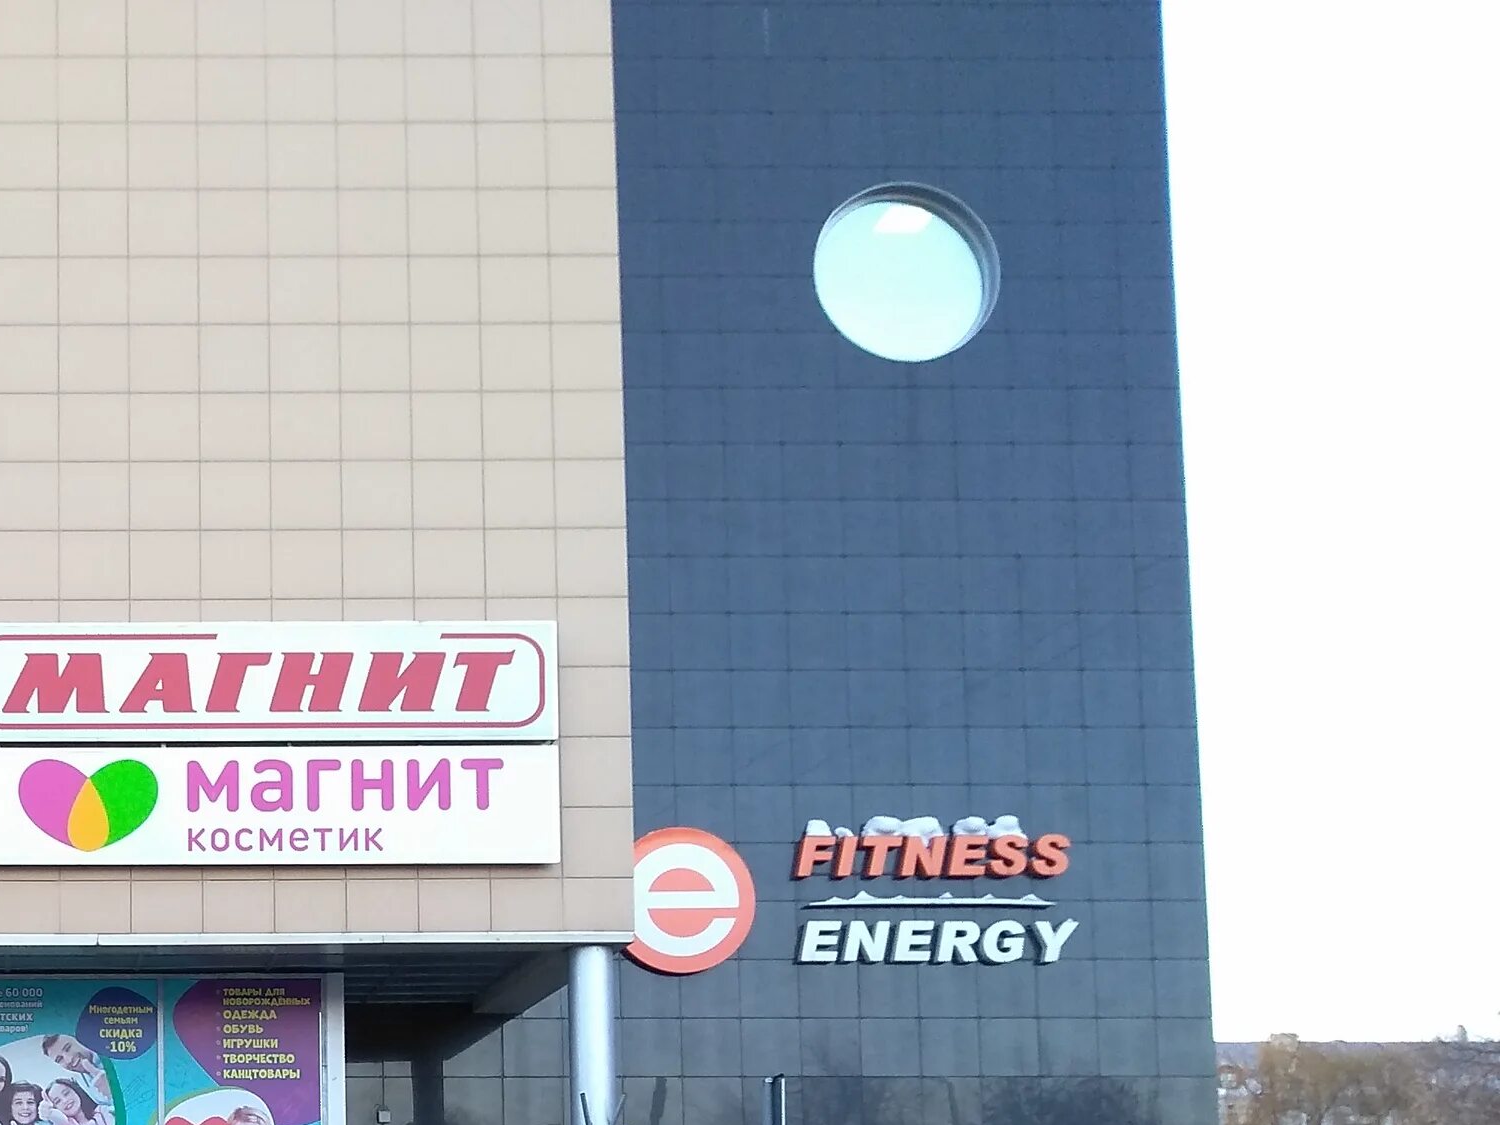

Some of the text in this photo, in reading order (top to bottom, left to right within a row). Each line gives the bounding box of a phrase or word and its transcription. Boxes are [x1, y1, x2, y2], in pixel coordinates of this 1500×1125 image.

[1, 649, 516, 714] МАГНИТ
[187, 827, 385, 853] косметик
[794, 832, 1071, 879] FITNESS
[798, 919, 1080, 965] ENERGY
[5, 988, 21, 998] 60
[22, 988, 43, 998] 000
[223, 988, 286, 997] ТОВАРЫ ДЛЯ
[88, 1005, 153, 1015] Многодетным
[223, 1010, 277, 1020] ОДЕЖДА
[103, 1016, 138, 1025] семьям
[99, 1028, 143, 1039] скидка
[223, 1024, 264, 1034] ОБУВЬ
[105, 1041, 137, 1053] -10%
[223, 1038, 279, 1049] ИГРУШКИ
[223, 1053, 296, 1064] ТВОРЧЕСТВО
[223, 1068, 301, 1080] КАНЦТОВАРЫ
